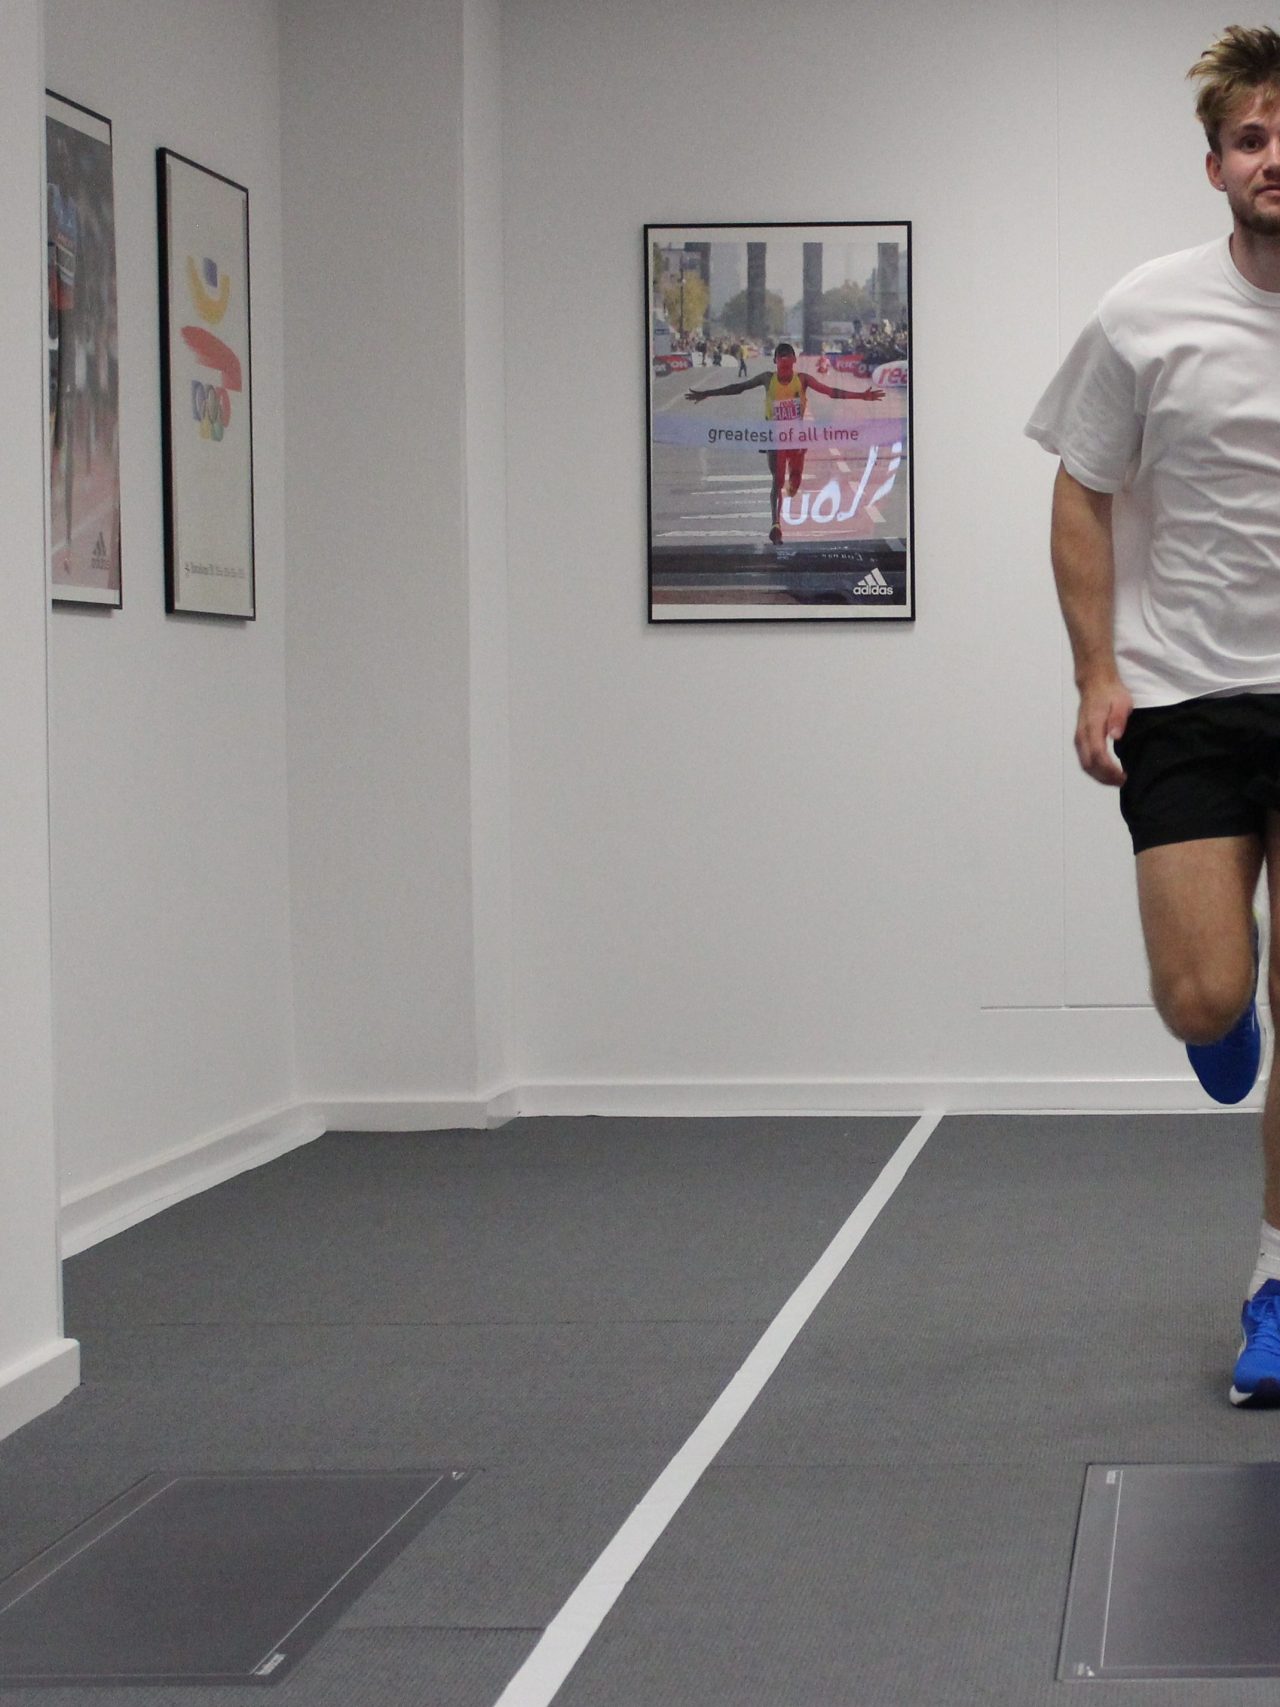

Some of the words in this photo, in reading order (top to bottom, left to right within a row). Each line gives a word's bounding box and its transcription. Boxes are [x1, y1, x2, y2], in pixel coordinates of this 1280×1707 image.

[708, 428, 773, 444] greatest
[779, 428, 794, 442] of
[798, 428, 818, 442] all
[823, 427, 859, 441] time
[853, 585, 894, 595] adidas
